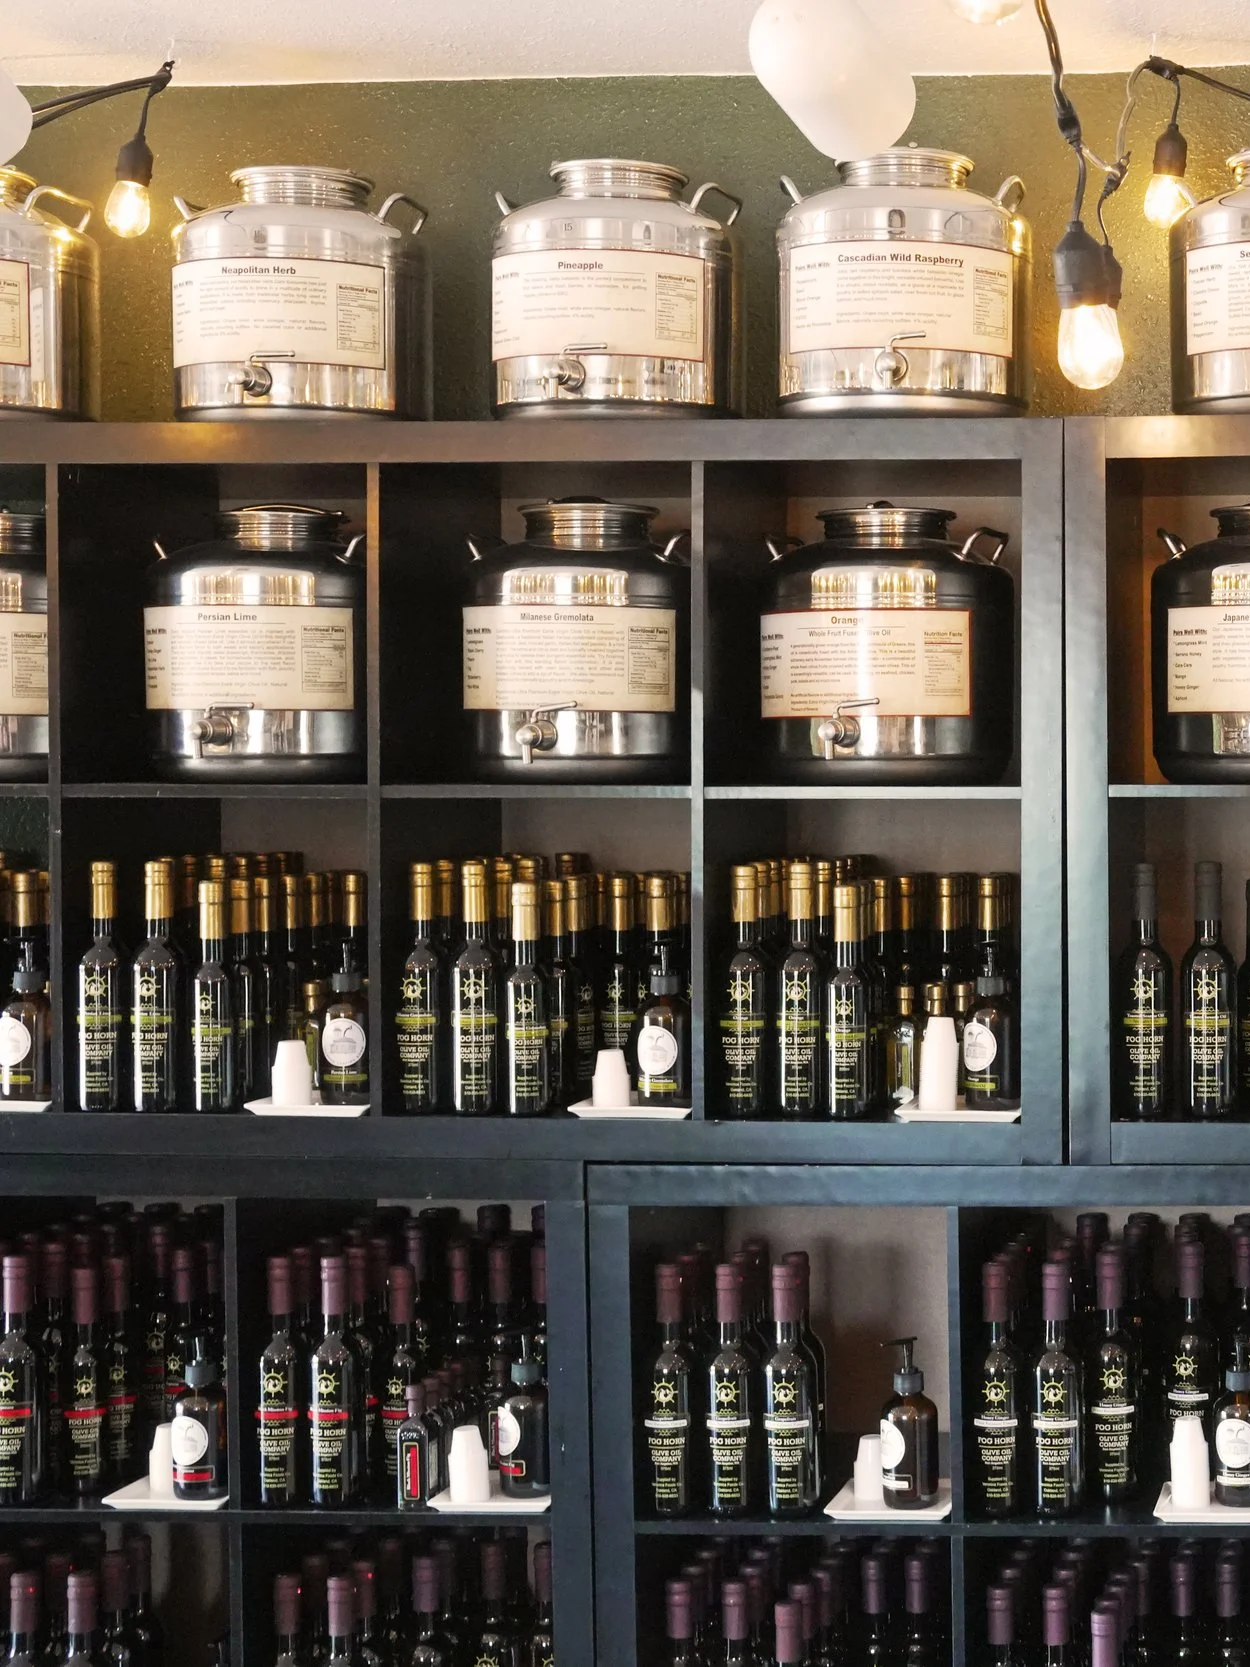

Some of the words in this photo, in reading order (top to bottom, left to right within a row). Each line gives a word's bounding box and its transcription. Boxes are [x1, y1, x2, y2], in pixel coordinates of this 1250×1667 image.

[564, 223, 572, 231] 15
[838, 254, 887, 263] Cascadian
[890, 253, 911, 262] Wild
[915, 254, 964, 267] Raspberry
[558, 261, 603, 270] Pineapple
[221, 267, 269, 275] Neapolitan
[273, 267, 296, 275] Herb
[198, 613, 230, 621] Persian
[554, 613, 594, 621] Gremolata
[272, 1427, 294, 1436] HORN
[648, 1437, 662, 1445] FOG
[663, 1437, 685, 1445] HORN
[978, 1437, 993, 1445] FOG
[994, 1436, 1015, 1444] HORN
